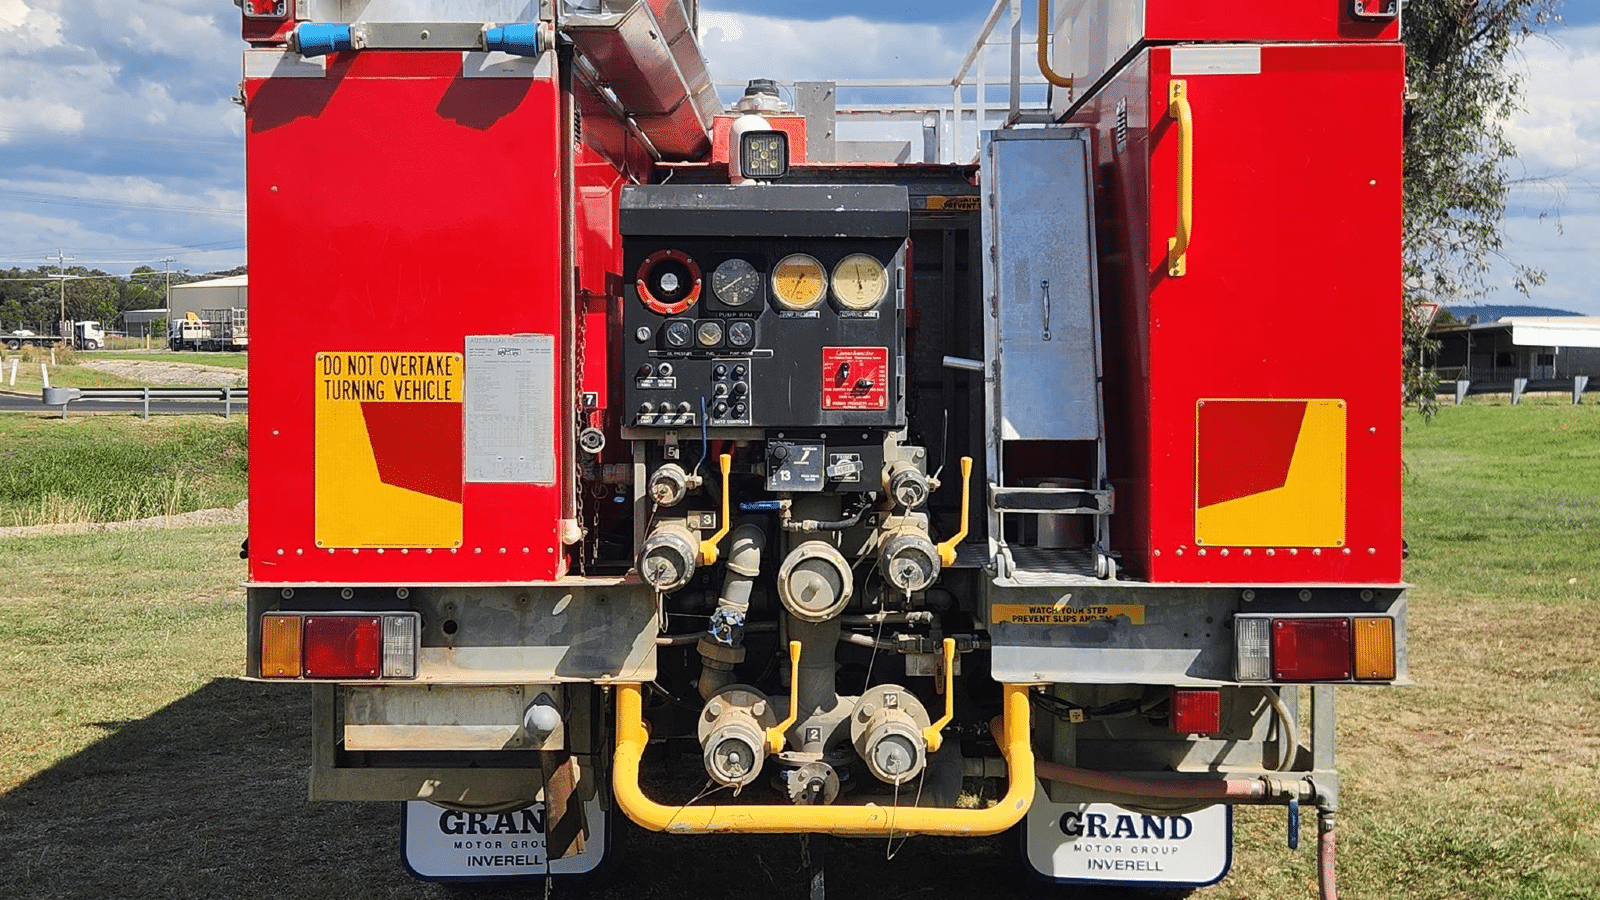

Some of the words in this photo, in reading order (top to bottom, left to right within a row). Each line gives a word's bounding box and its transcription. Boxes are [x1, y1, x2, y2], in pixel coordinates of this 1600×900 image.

[324, 355, 342, 376] DO
[348, 355, 374, 376] NOT
[381, 355, 453, 376] OVERTAKE
[325, 379, 385, 400] TURNING
[394, 379, 452, 400] VEHICLE
[586, 395, 594, 405] 7
[667, 446, 676, 457] 5
[780, 469, 792, 481] 13
[703, 514, 711, 525] 3
[868, 515, 876, 525] 4
[1028, 606, 1058, 614] WATCH
[1061, 606, 1085, 614] YOUR
[1087, 606, 1108, 614] STEP
[1012, 615, 1050, 623] PREVENT
[1053, 615, 1077, 623] SLIPS
[885, 694, 898, 706] 12
[810, 729, 819, 739] 2
[439, 809, 546, 835] GRAN
[1059, 811, 1193, 840] GRAND
[454, 840, 502, 849] MOTOR
[511, 840, 547, 849] GROU
[1073, 844, 1122, 853] MOTOR
[1131, 845, 1179, 855] GROUP
[467, 855, 543, 867] INVERELL
[1088, 858, 1164, 872] INVERELL
